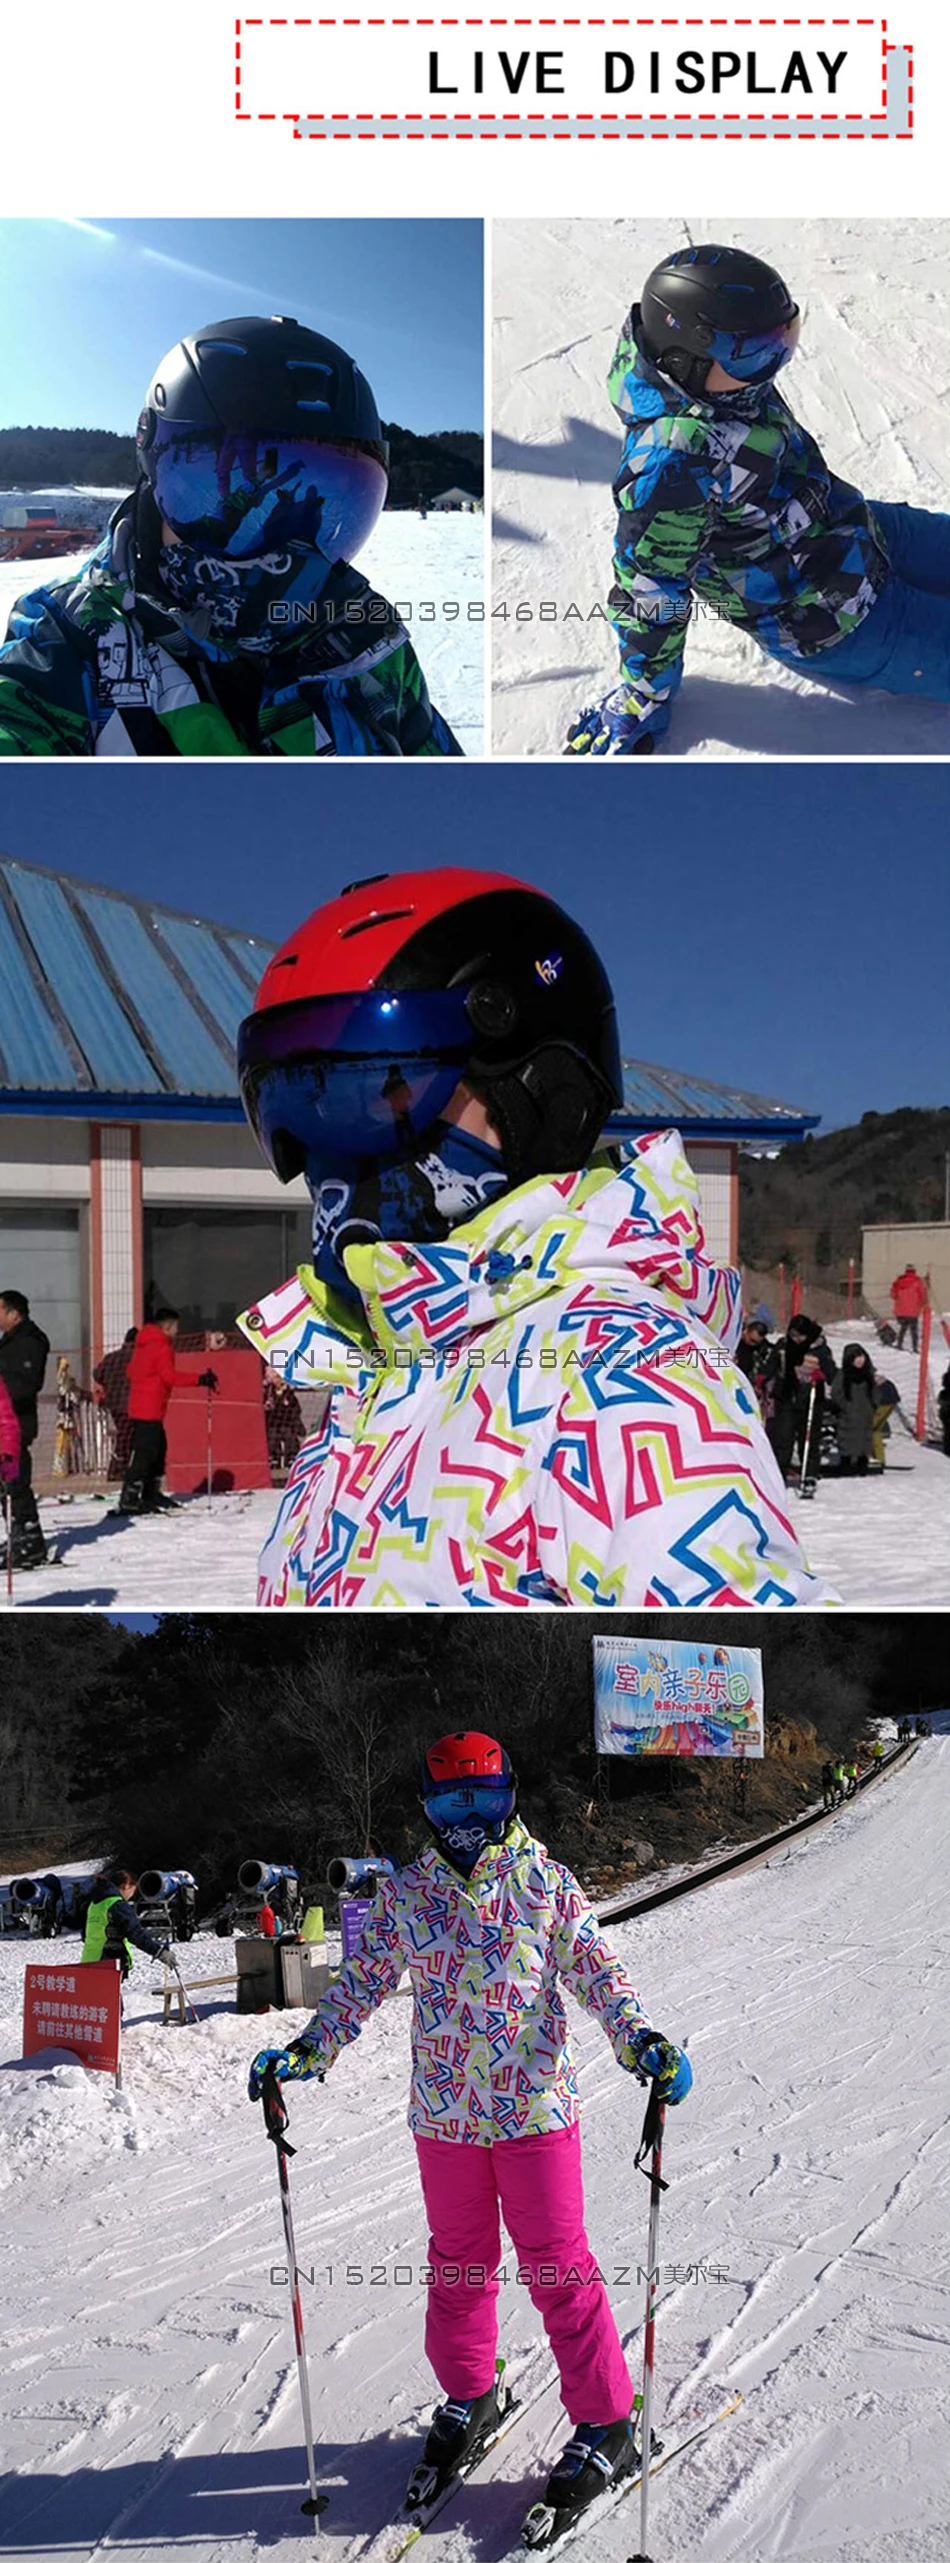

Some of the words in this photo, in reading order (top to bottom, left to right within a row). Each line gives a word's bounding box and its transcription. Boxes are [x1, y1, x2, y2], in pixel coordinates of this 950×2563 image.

[614, 1663, 751, 1704] 室内亲子乐园
[30, 1974, 76, 1993] 2号教学道
[32, 2001, 109, 2023] 未聘请教练的游客
[37, 2020, 103, 2043] 请前往其他雪道
